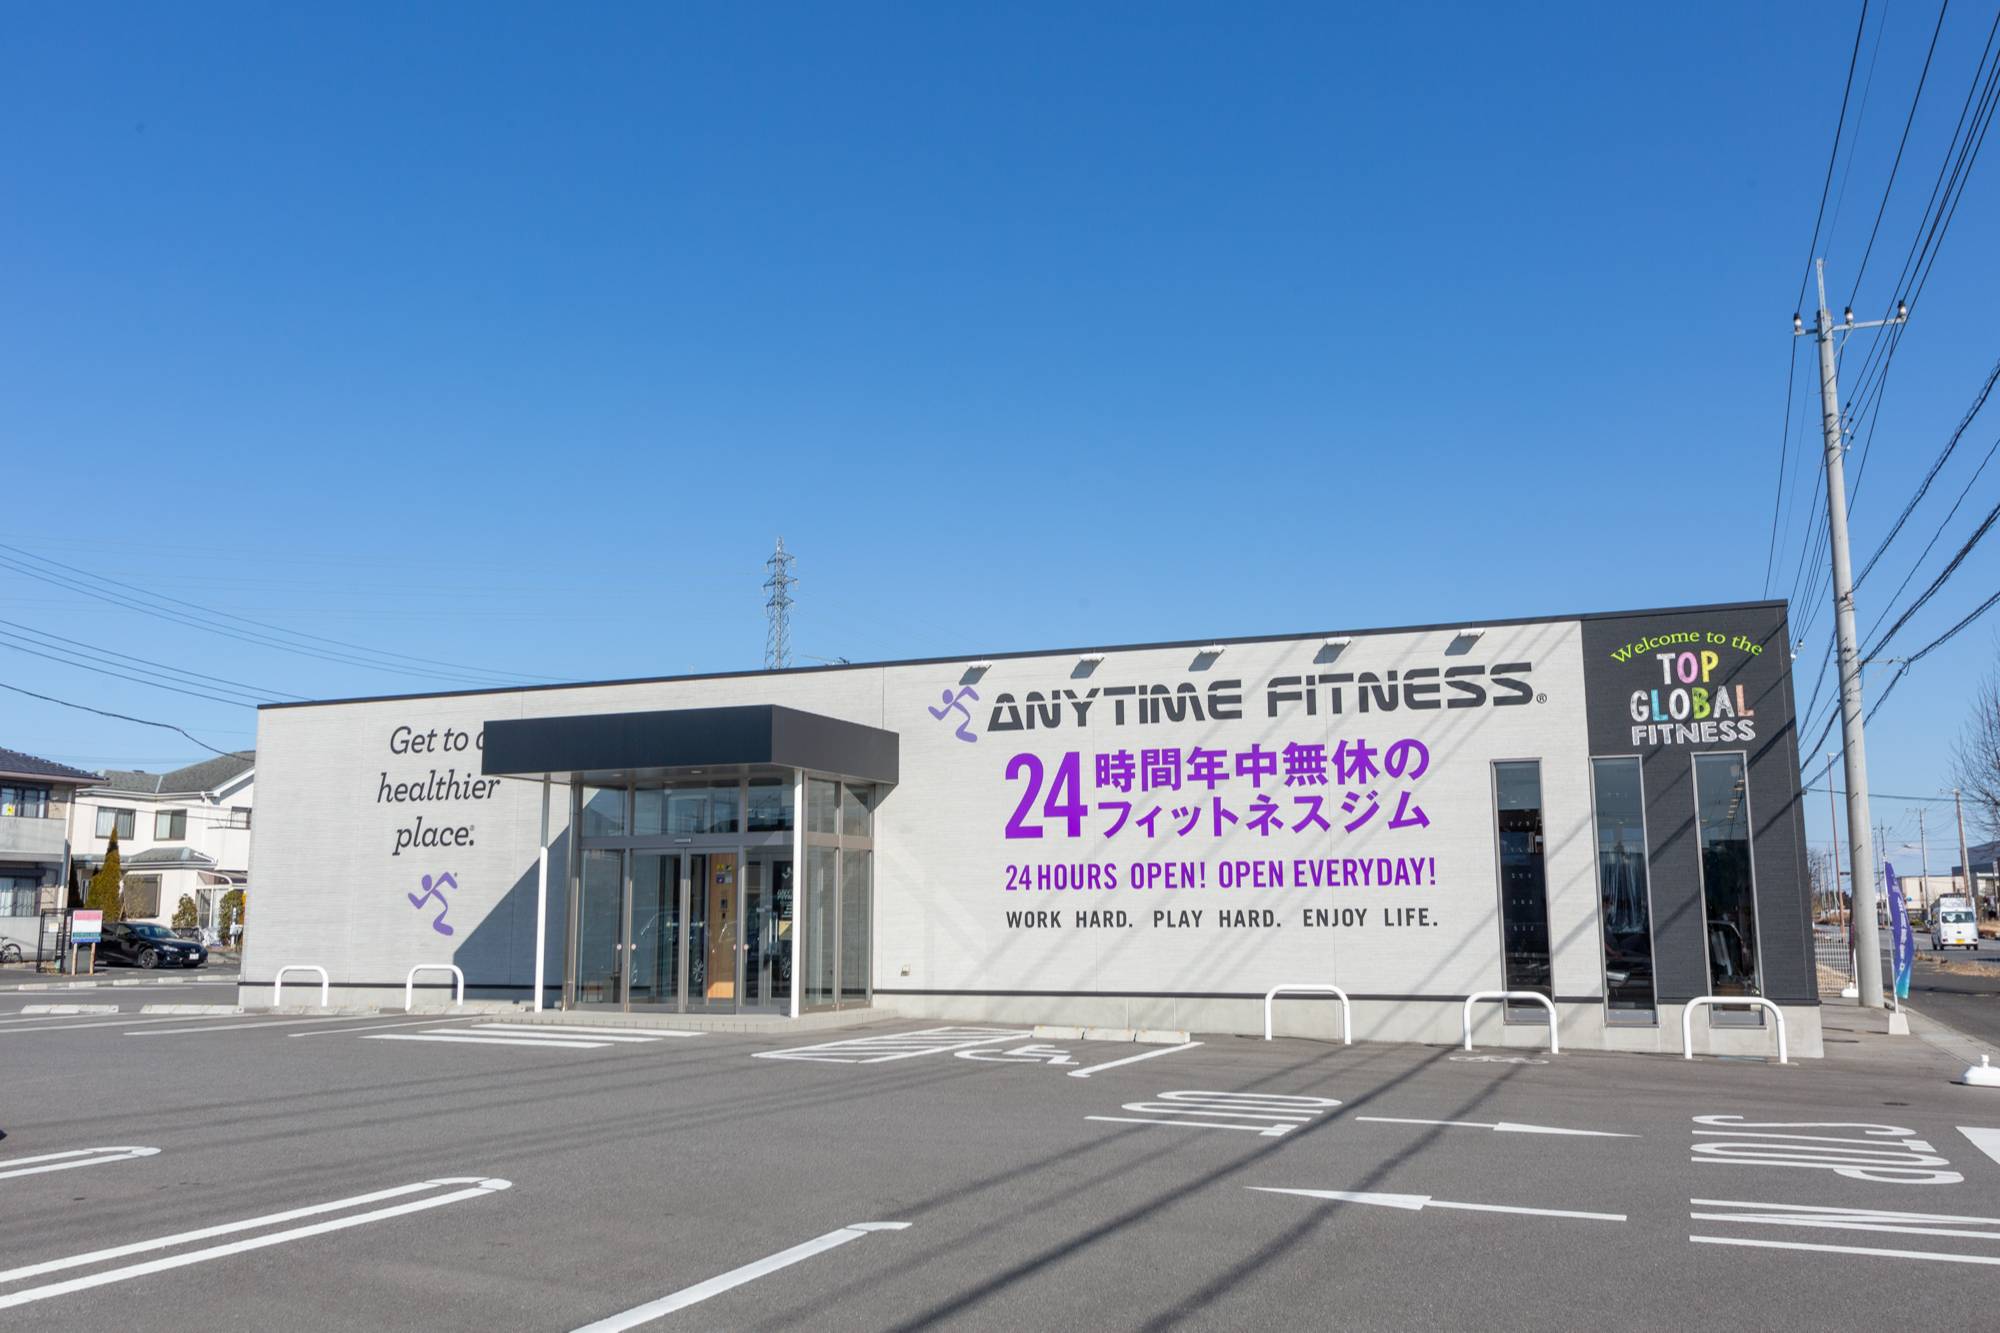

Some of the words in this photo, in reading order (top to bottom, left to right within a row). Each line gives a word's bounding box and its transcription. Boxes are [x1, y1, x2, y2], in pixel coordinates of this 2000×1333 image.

[1611, 631, 1700, 663] Welcome
[1706, 631, 1726, 644] to
[1731, 635, 1763, 656] the
[1656, 650, 1719, 685] TOP
[987, 679, 1242, 731] ANYTIME
[1630, 684, 1754, 722] GLOBAL
[390, 726, 438, 755] Get
[443, 728, 469, 752] to
[1631, 719, 1756, 746] FITNESS
[1095, 738, 1430, 792] 時間年中無休の
[377, 769, 501, 803] healthier
[1097, 790, 1431, 839] フィットネスジム
[1130, 862, 1206, 889] OPEN!
[1218, 860, 1284, 889] OPEN
[1293, 857, 1437, 887] EVERYDAY!
[1006, 911, 1062, 929] WORK
[1075, 911, 1134, 928] HARD.
[1153, 910, 1203, 928] PLAY
[1219, 909, 1282, 928] HARD.
[1303, 908, 1368, 927] ENJOY
[1384, 908, 1439, 927] LIFE.
[1083, 1090, 1343, 1137] OUT
[1690, 1115, 1965, 1185] STOP
